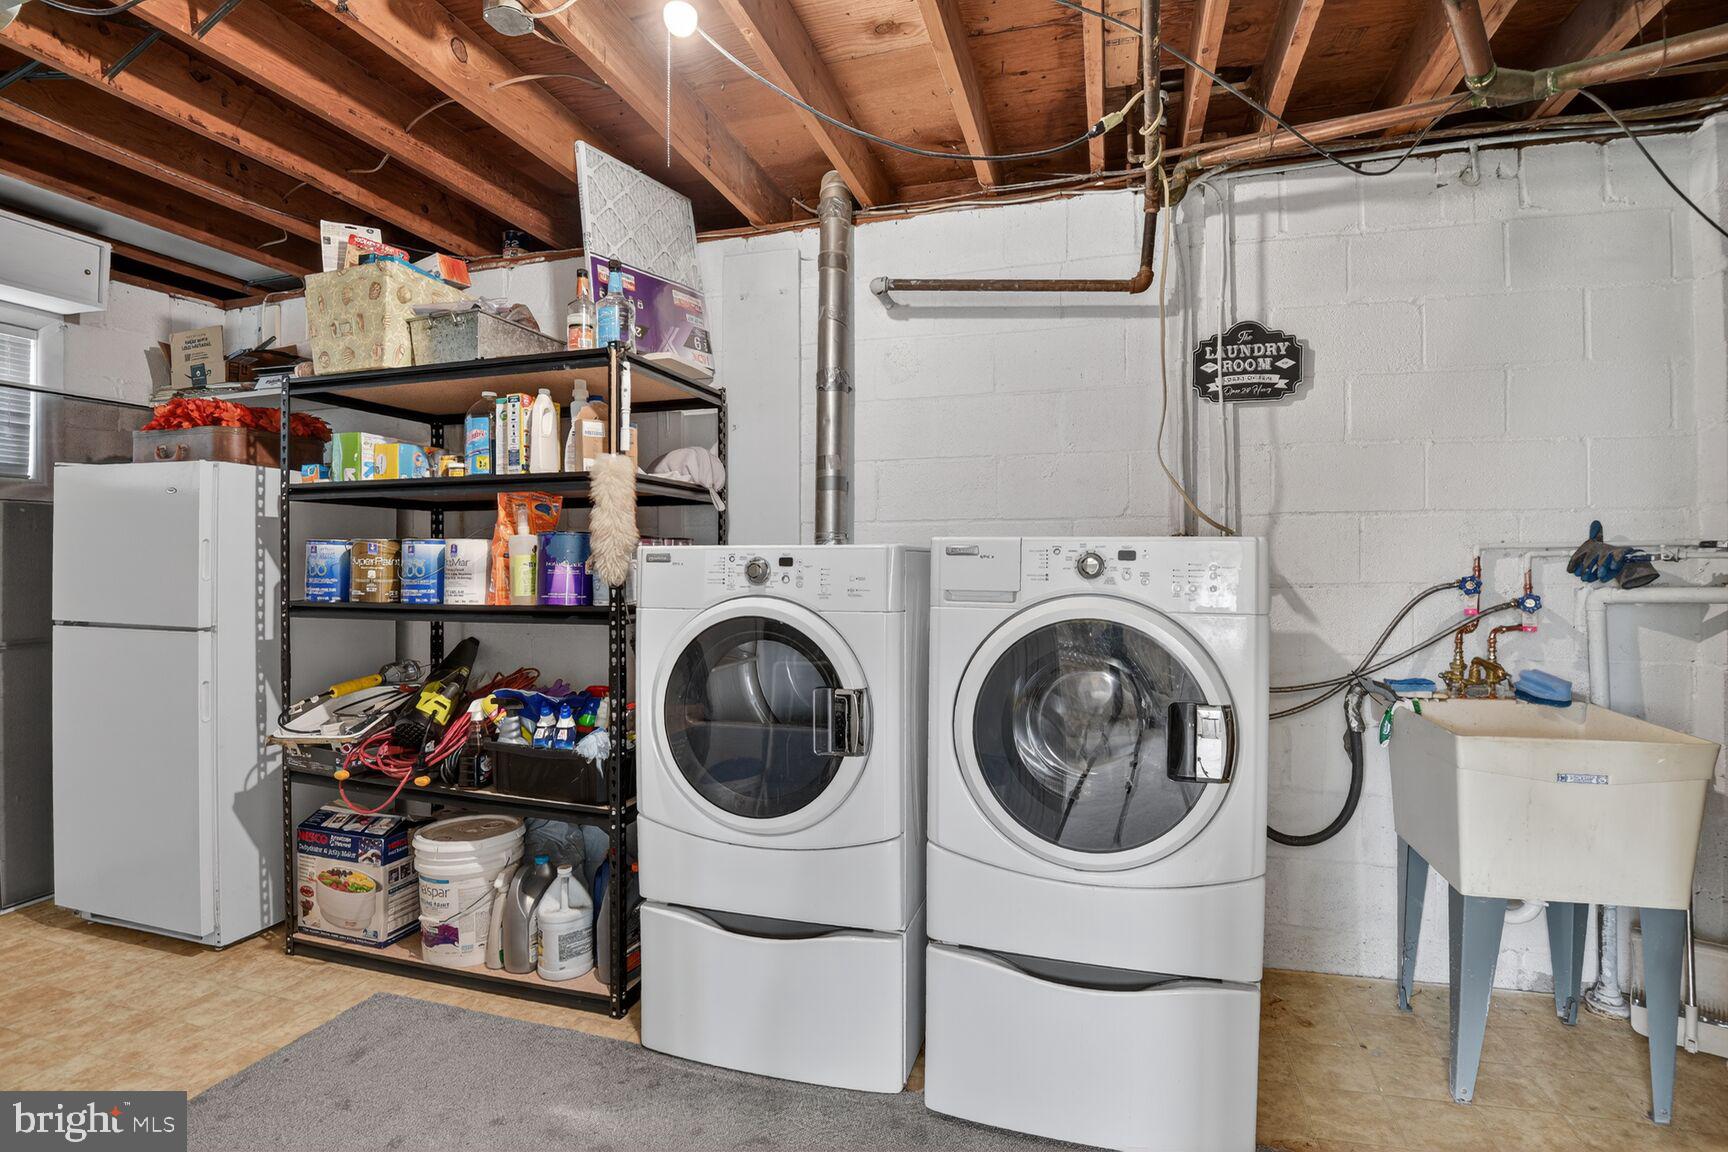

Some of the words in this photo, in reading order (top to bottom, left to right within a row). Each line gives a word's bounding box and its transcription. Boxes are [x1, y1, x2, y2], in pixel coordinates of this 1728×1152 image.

[1236, 329, 1254, 344] The
[1205, 342, 1291, 359] LAUNDRY
[1222, 358, 1273, 372] ROOM
